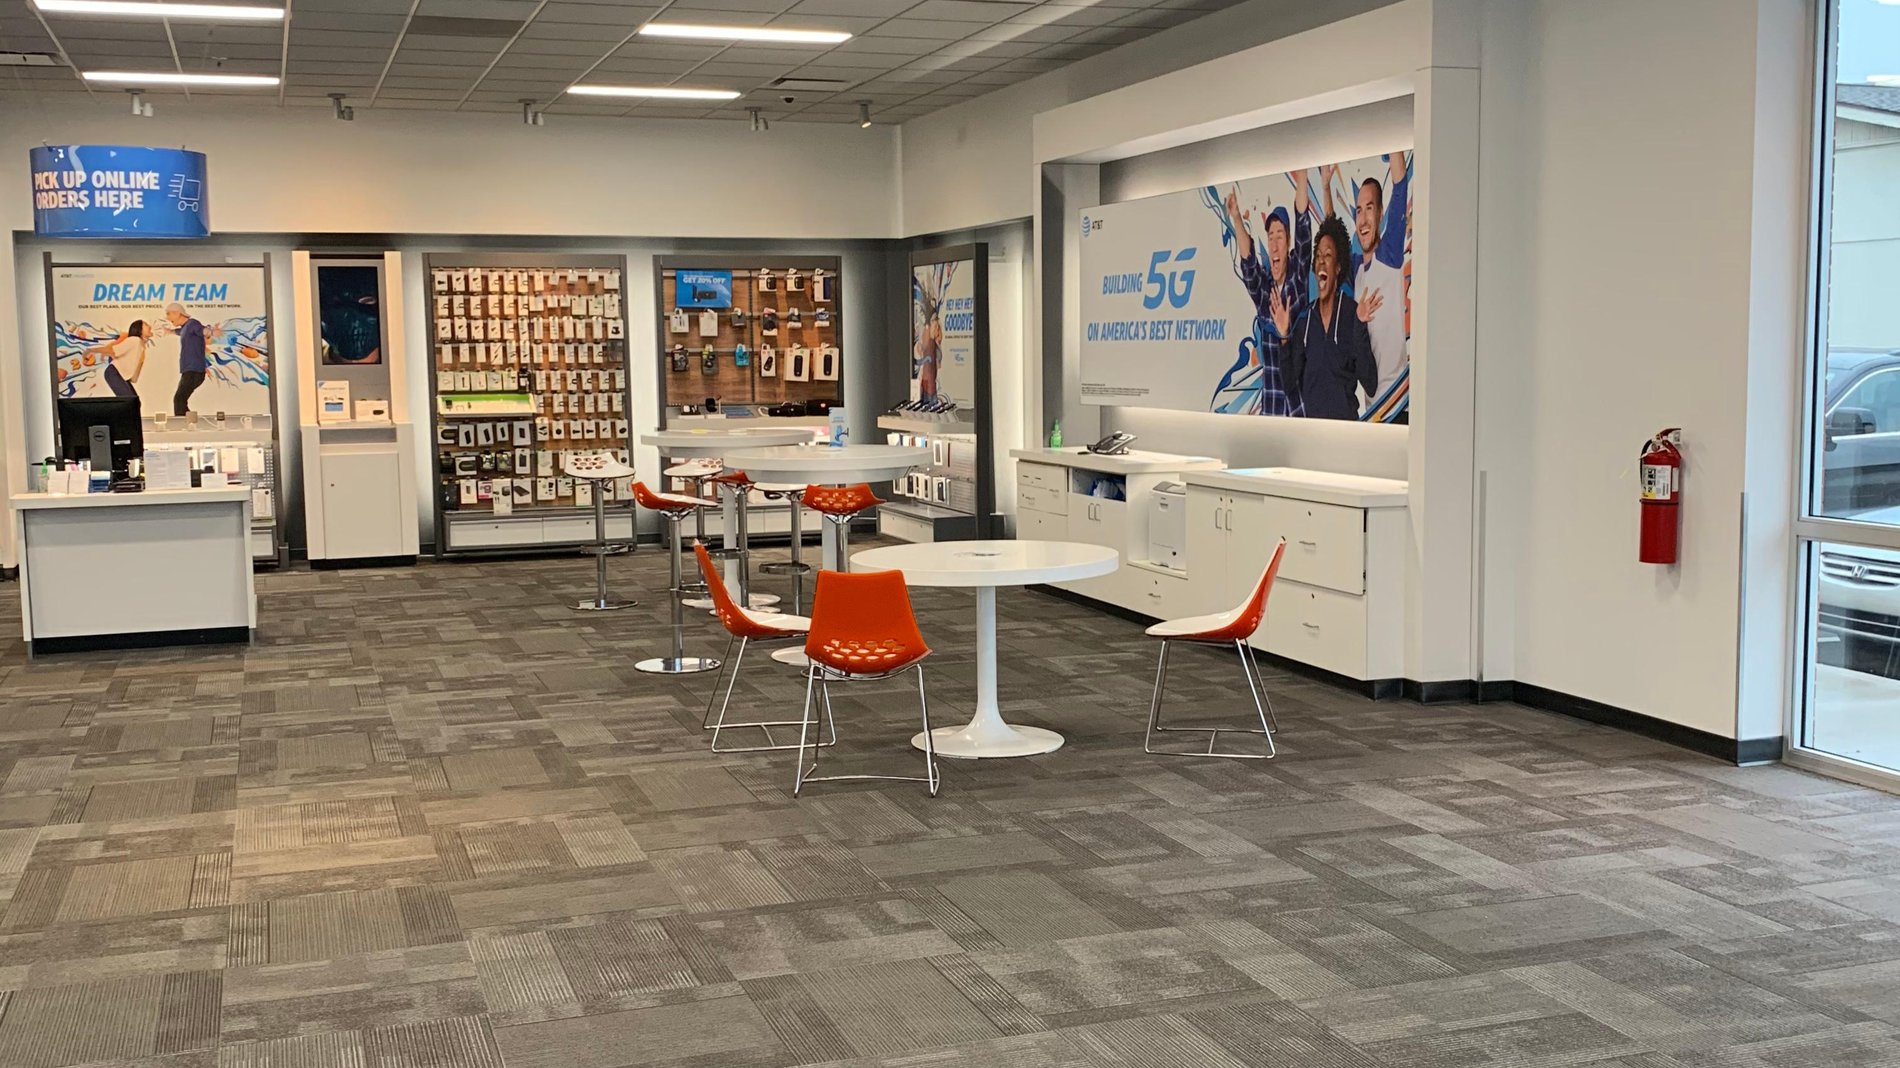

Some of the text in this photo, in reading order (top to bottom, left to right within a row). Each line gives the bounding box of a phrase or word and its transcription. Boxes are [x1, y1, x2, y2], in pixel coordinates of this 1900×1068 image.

[34, 170, 160, 190] PICK UP ONLINE
[36, 189, 144, 210] ORDERS HERE
[1103, 247, 1198, 310] BUILDING 5G
[93, 283, 228, 302] DREAM TEAM
[1087, 319, 1227, 342] ON AMERICA'S BEST NETWORK
